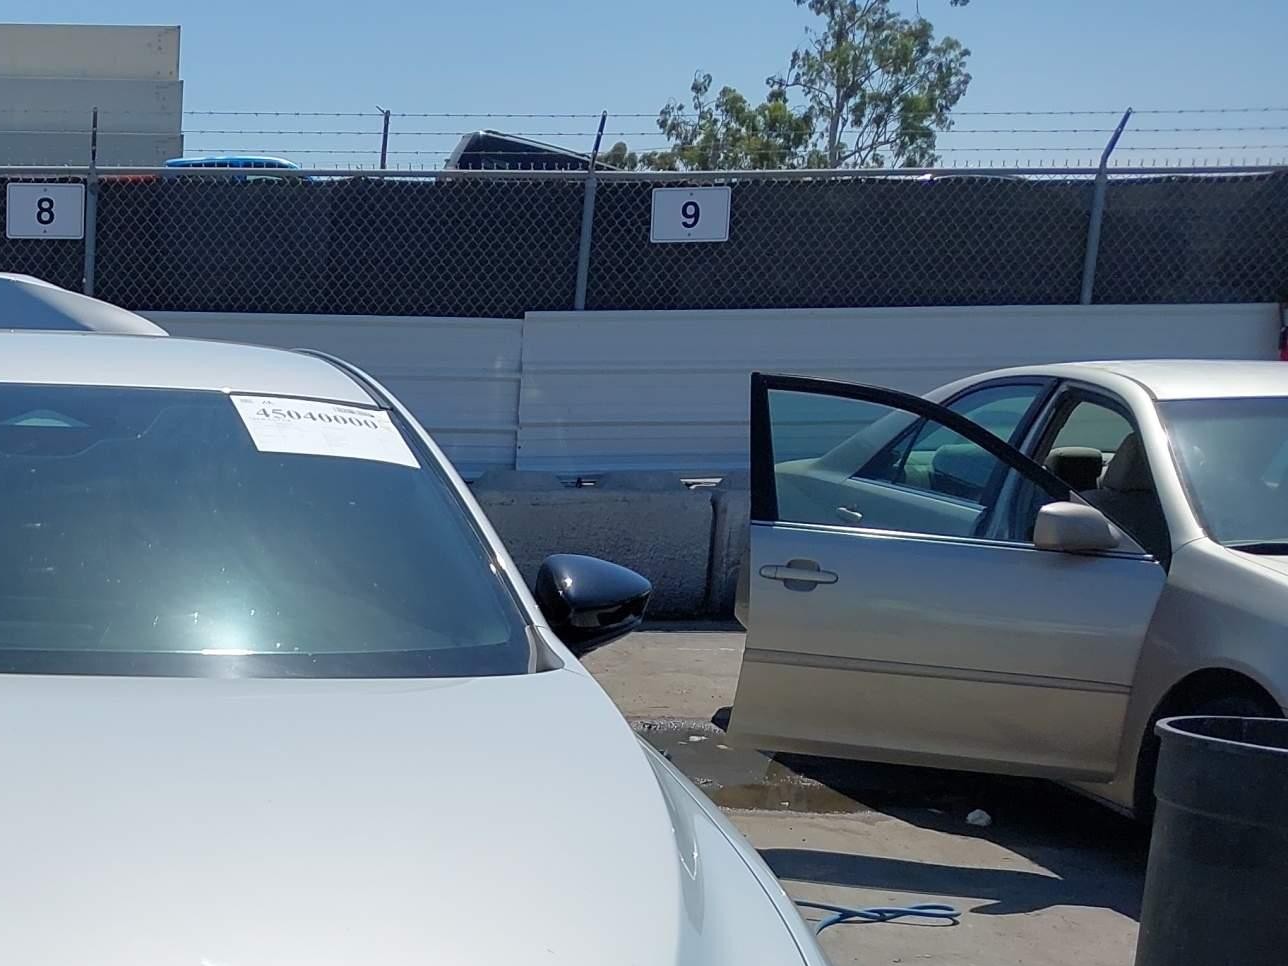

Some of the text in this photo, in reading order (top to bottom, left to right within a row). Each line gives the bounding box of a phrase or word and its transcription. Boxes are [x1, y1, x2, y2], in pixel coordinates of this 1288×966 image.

[36, 197, 55, 225] 8
[681, 201, 700, 229] 9
[256, 407, 379, 430] 45040000
